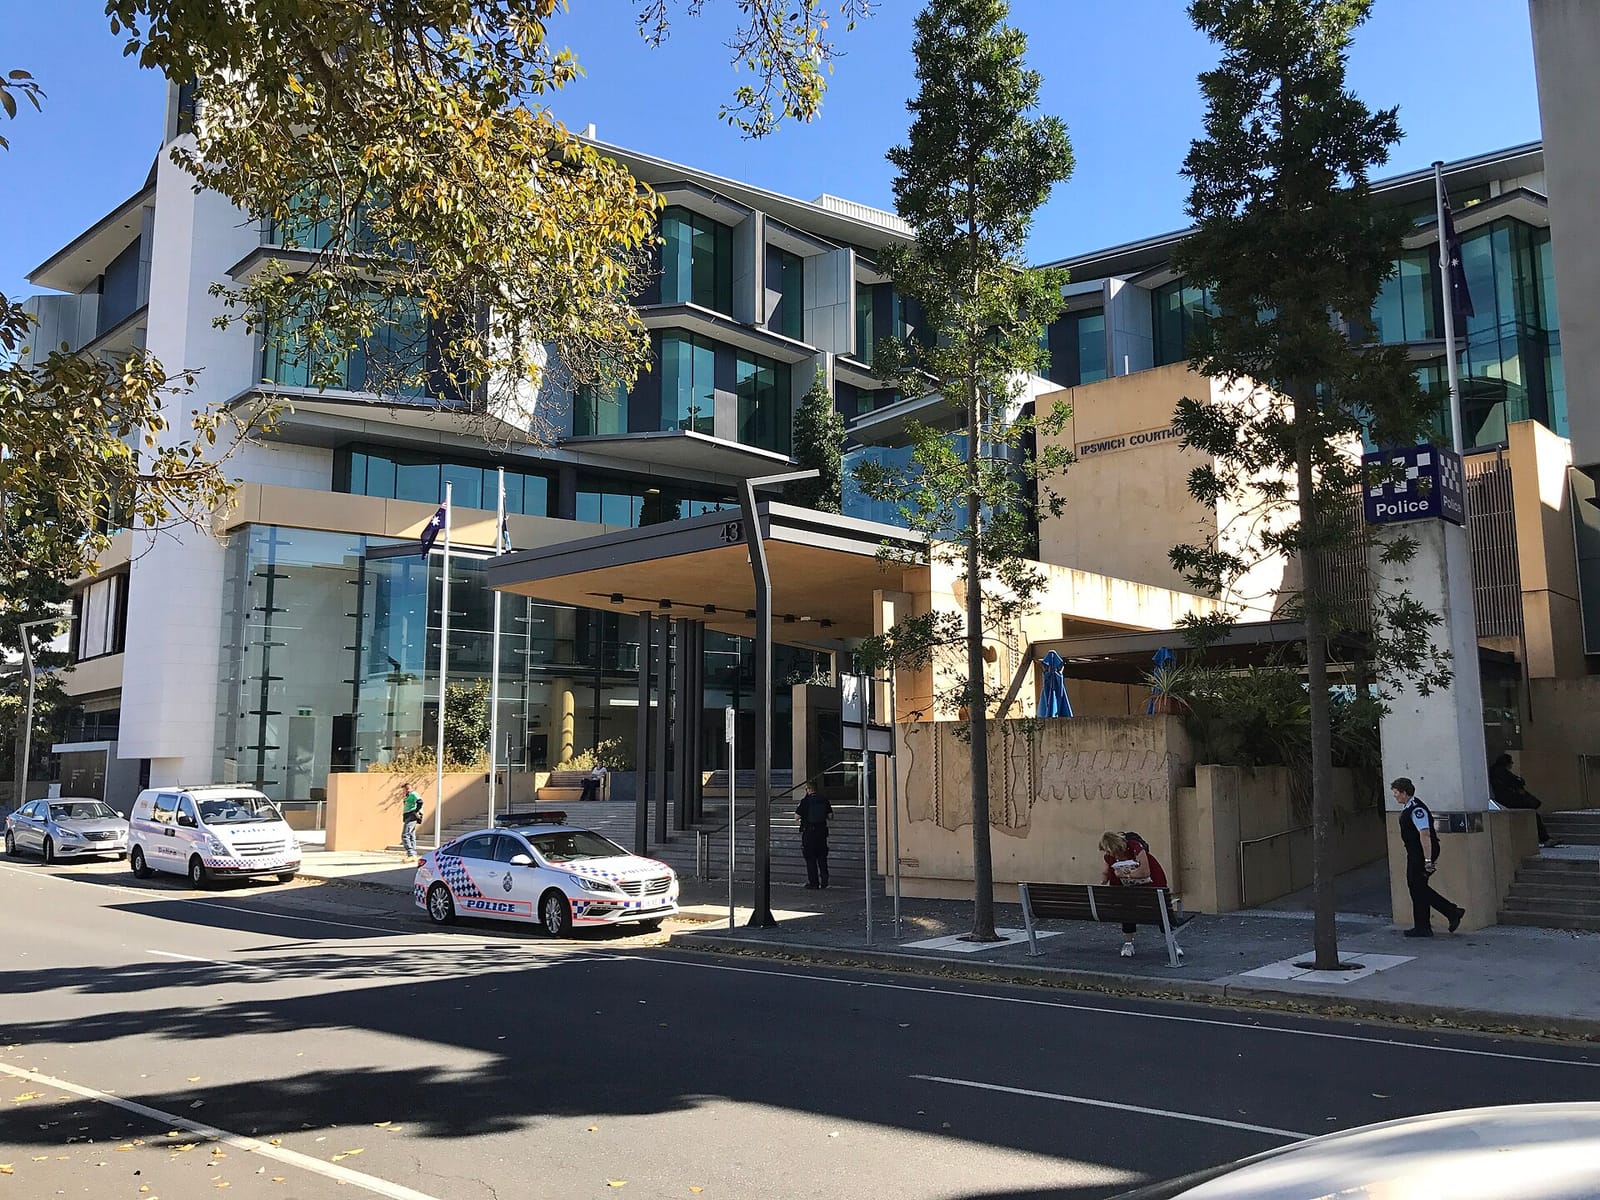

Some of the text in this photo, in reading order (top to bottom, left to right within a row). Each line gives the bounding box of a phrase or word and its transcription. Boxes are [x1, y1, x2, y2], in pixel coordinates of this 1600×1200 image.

[1080, 438, 1125, 456] IPSWICH
[1376, 500, 1429, 517] Police
[719, 522, 738, 542] 43
[466, 899, 516, 913] POLICE
